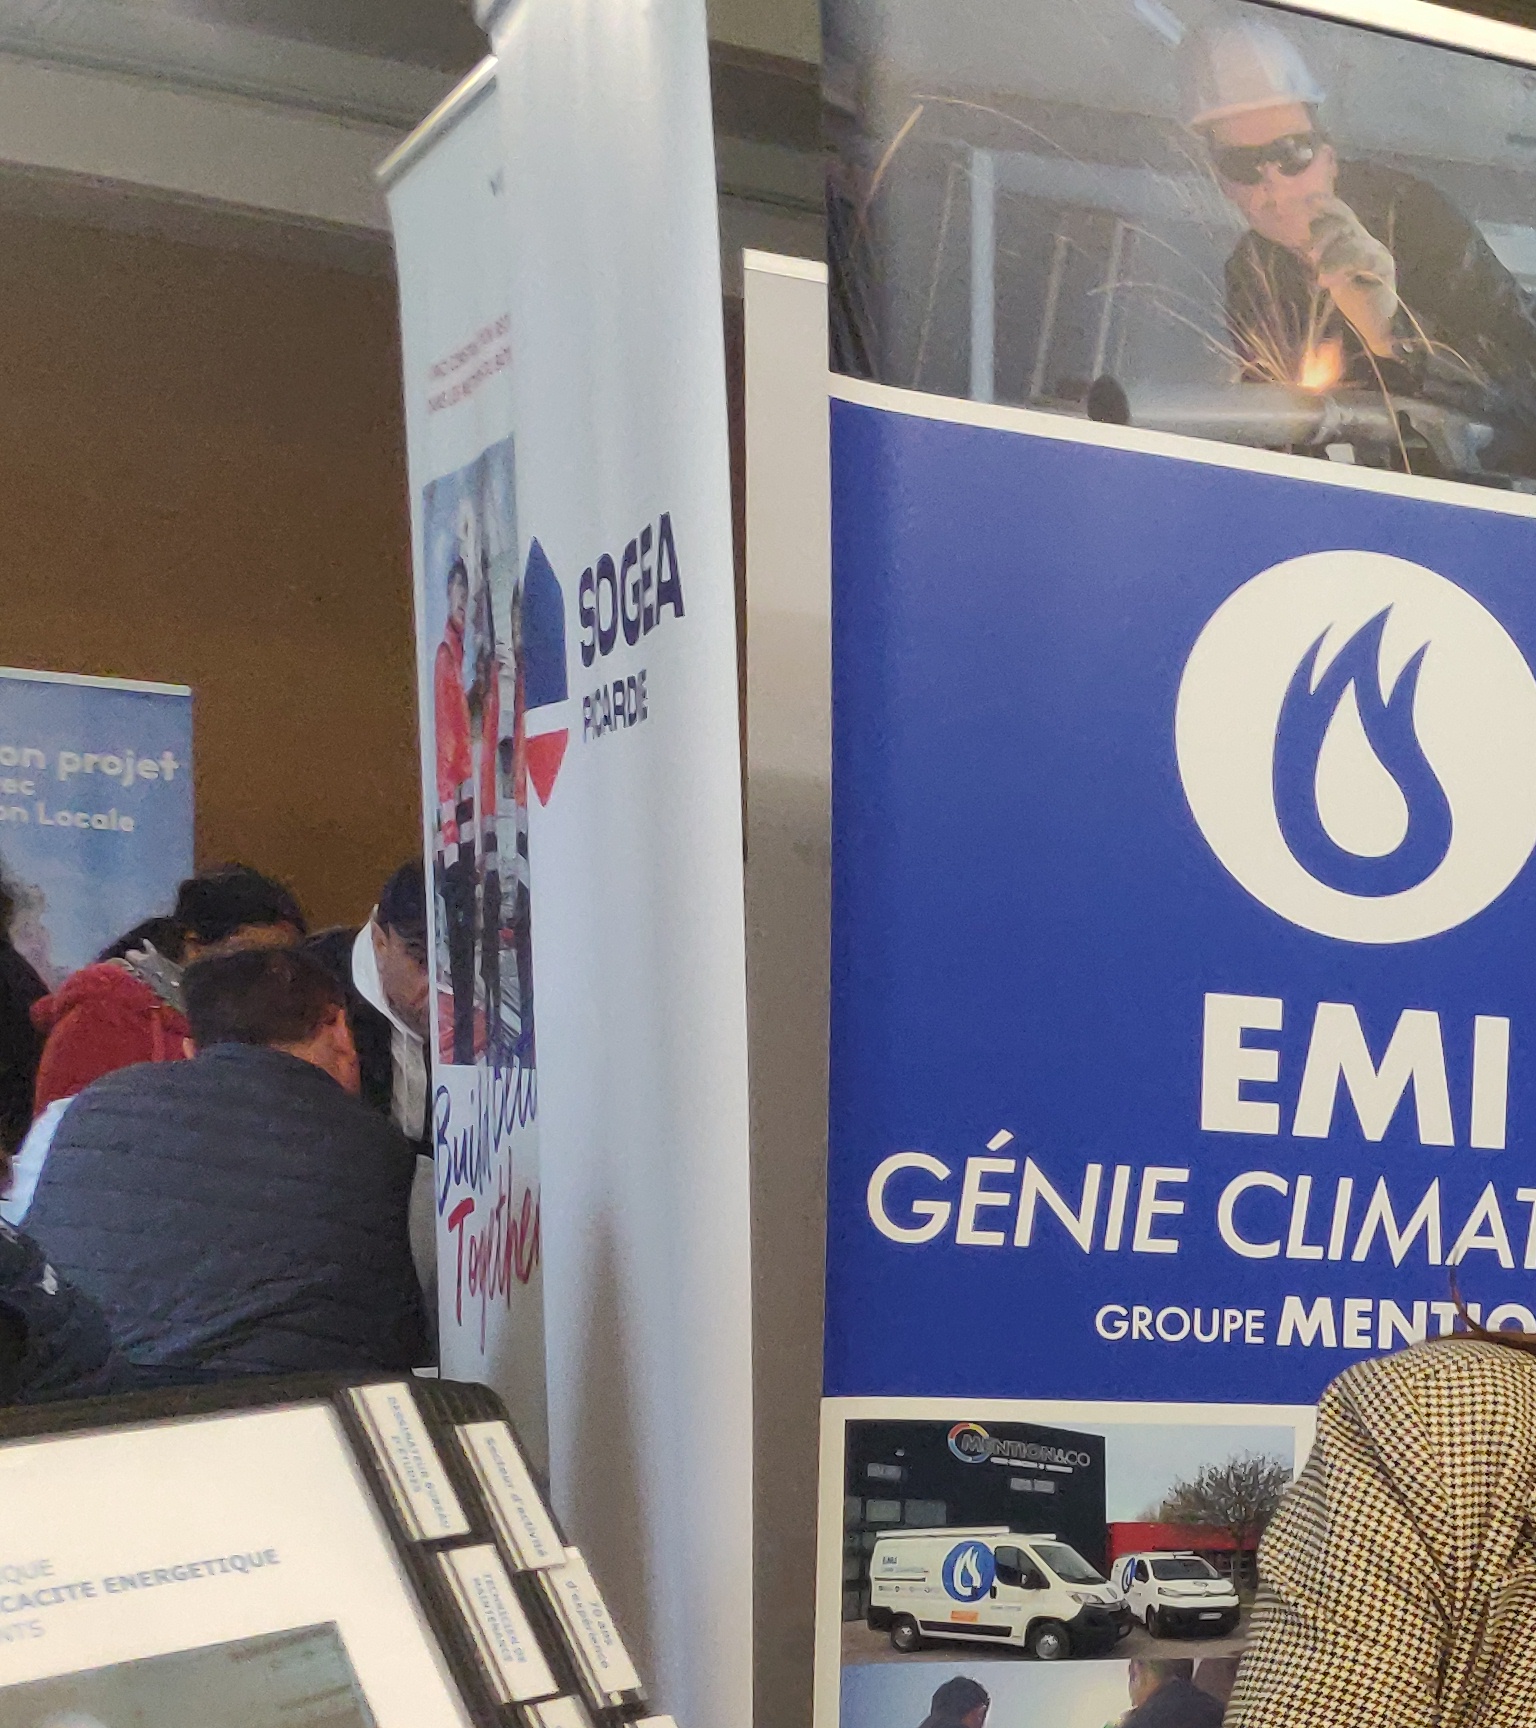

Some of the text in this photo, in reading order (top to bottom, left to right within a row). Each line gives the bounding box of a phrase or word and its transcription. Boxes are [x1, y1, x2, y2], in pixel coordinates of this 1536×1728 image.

[578, 511, 686, 668] SOGEA
[58, 749, 180, 787] projet
[38, 802, 136, 832] Locale
[1200, 992, 1511, 1150] EMI
[866, 1129, 1191, 1255] GÉNIE
[1095, 1302, 1266, 1345] GROUPE
[103, 1547, 281, 1595] ENERGETIQUE
